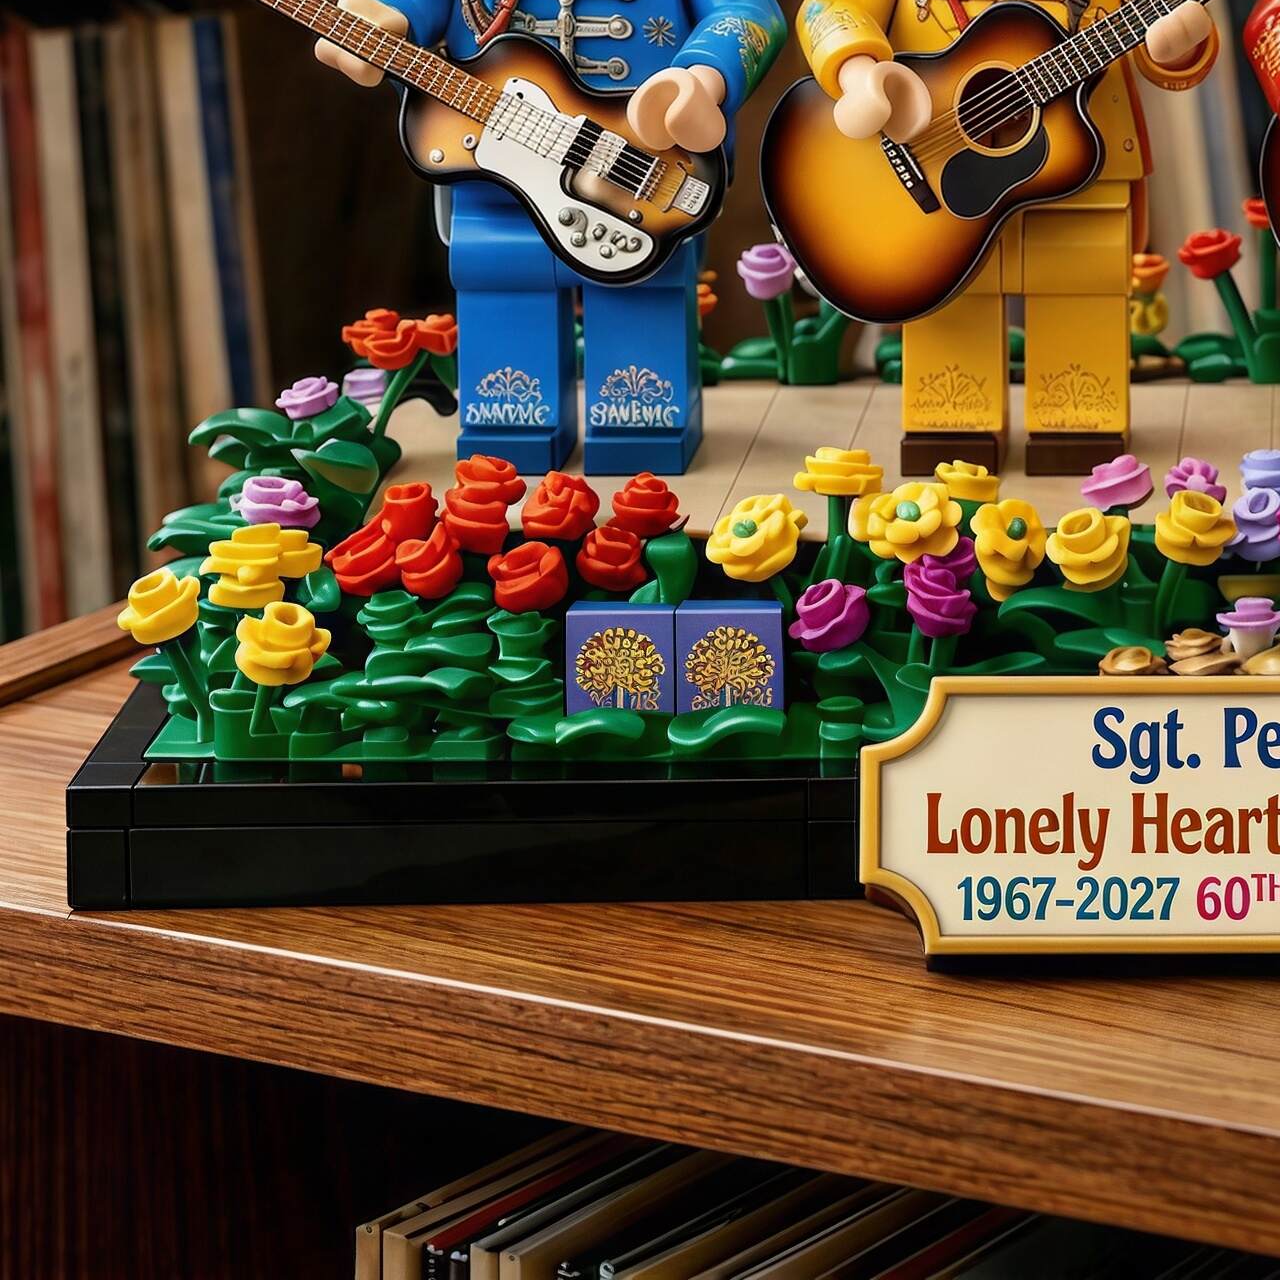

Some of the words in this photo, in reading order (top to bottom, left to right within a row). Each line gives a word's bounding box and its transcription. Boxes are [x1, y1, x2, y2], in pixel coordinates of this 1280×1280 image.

[1091, 706, 1202, 784] Sgt.
[926, 792, 1110, 872] Lonely
[958, 875, 1181, 921] 1967-2027
